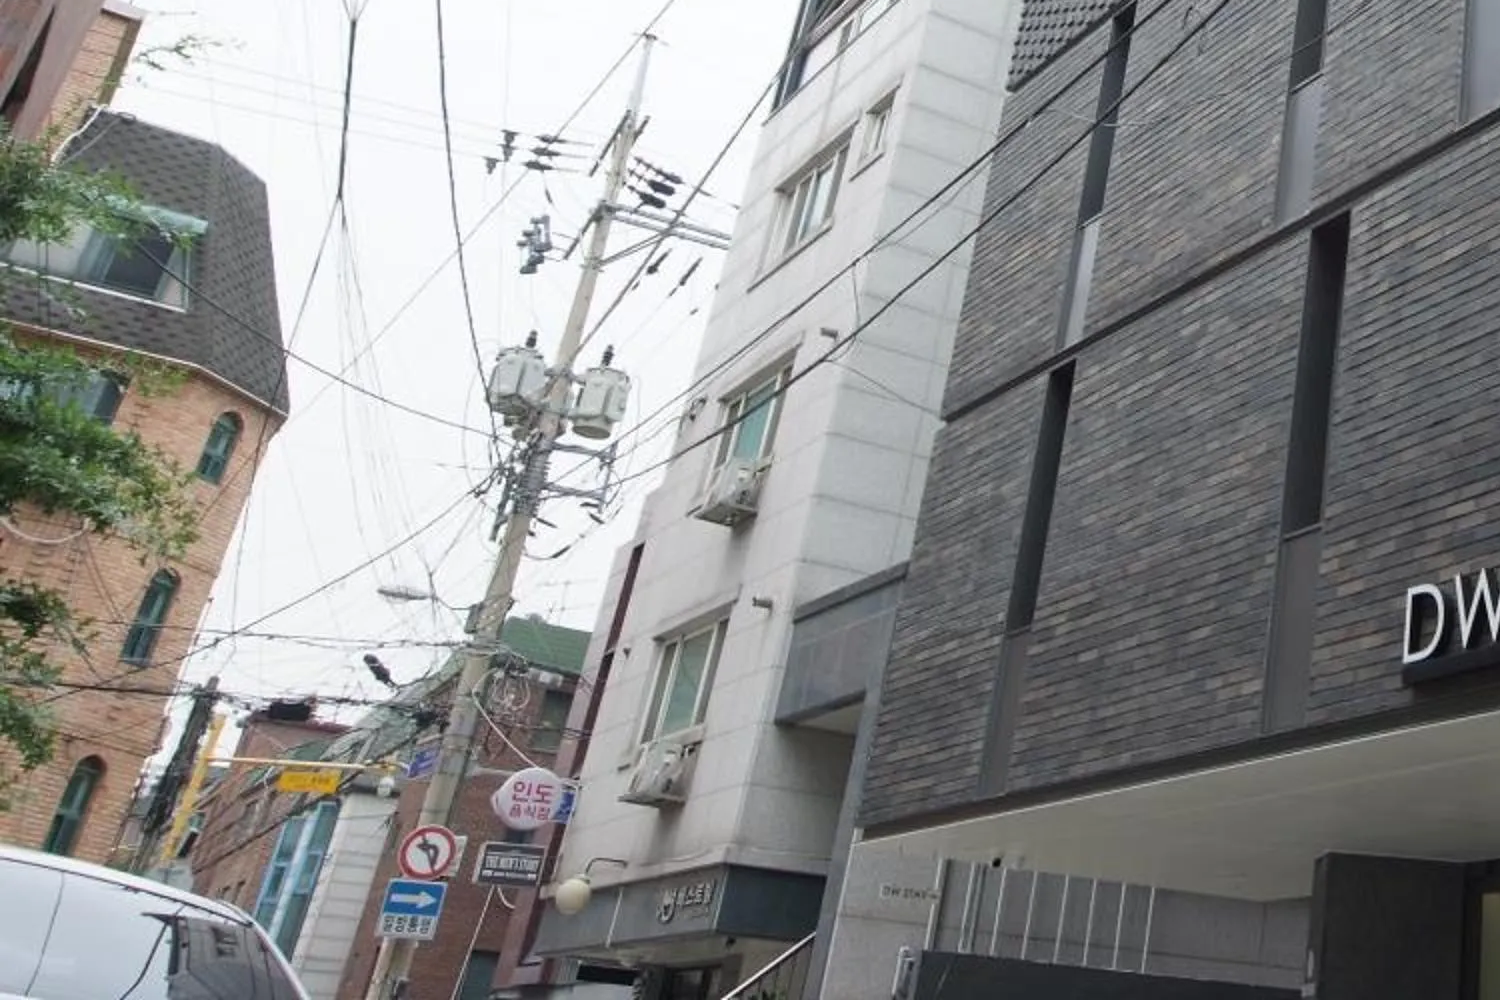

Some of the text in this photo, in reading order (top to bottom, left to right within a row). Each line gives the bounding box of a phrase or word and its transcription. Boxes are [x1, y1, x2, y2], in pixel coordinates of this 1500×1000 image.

[511, 780, 553, 804] 인도
[509, 804, 551, 821] 음식점
[383, 915, 431, 935] 일방통행
